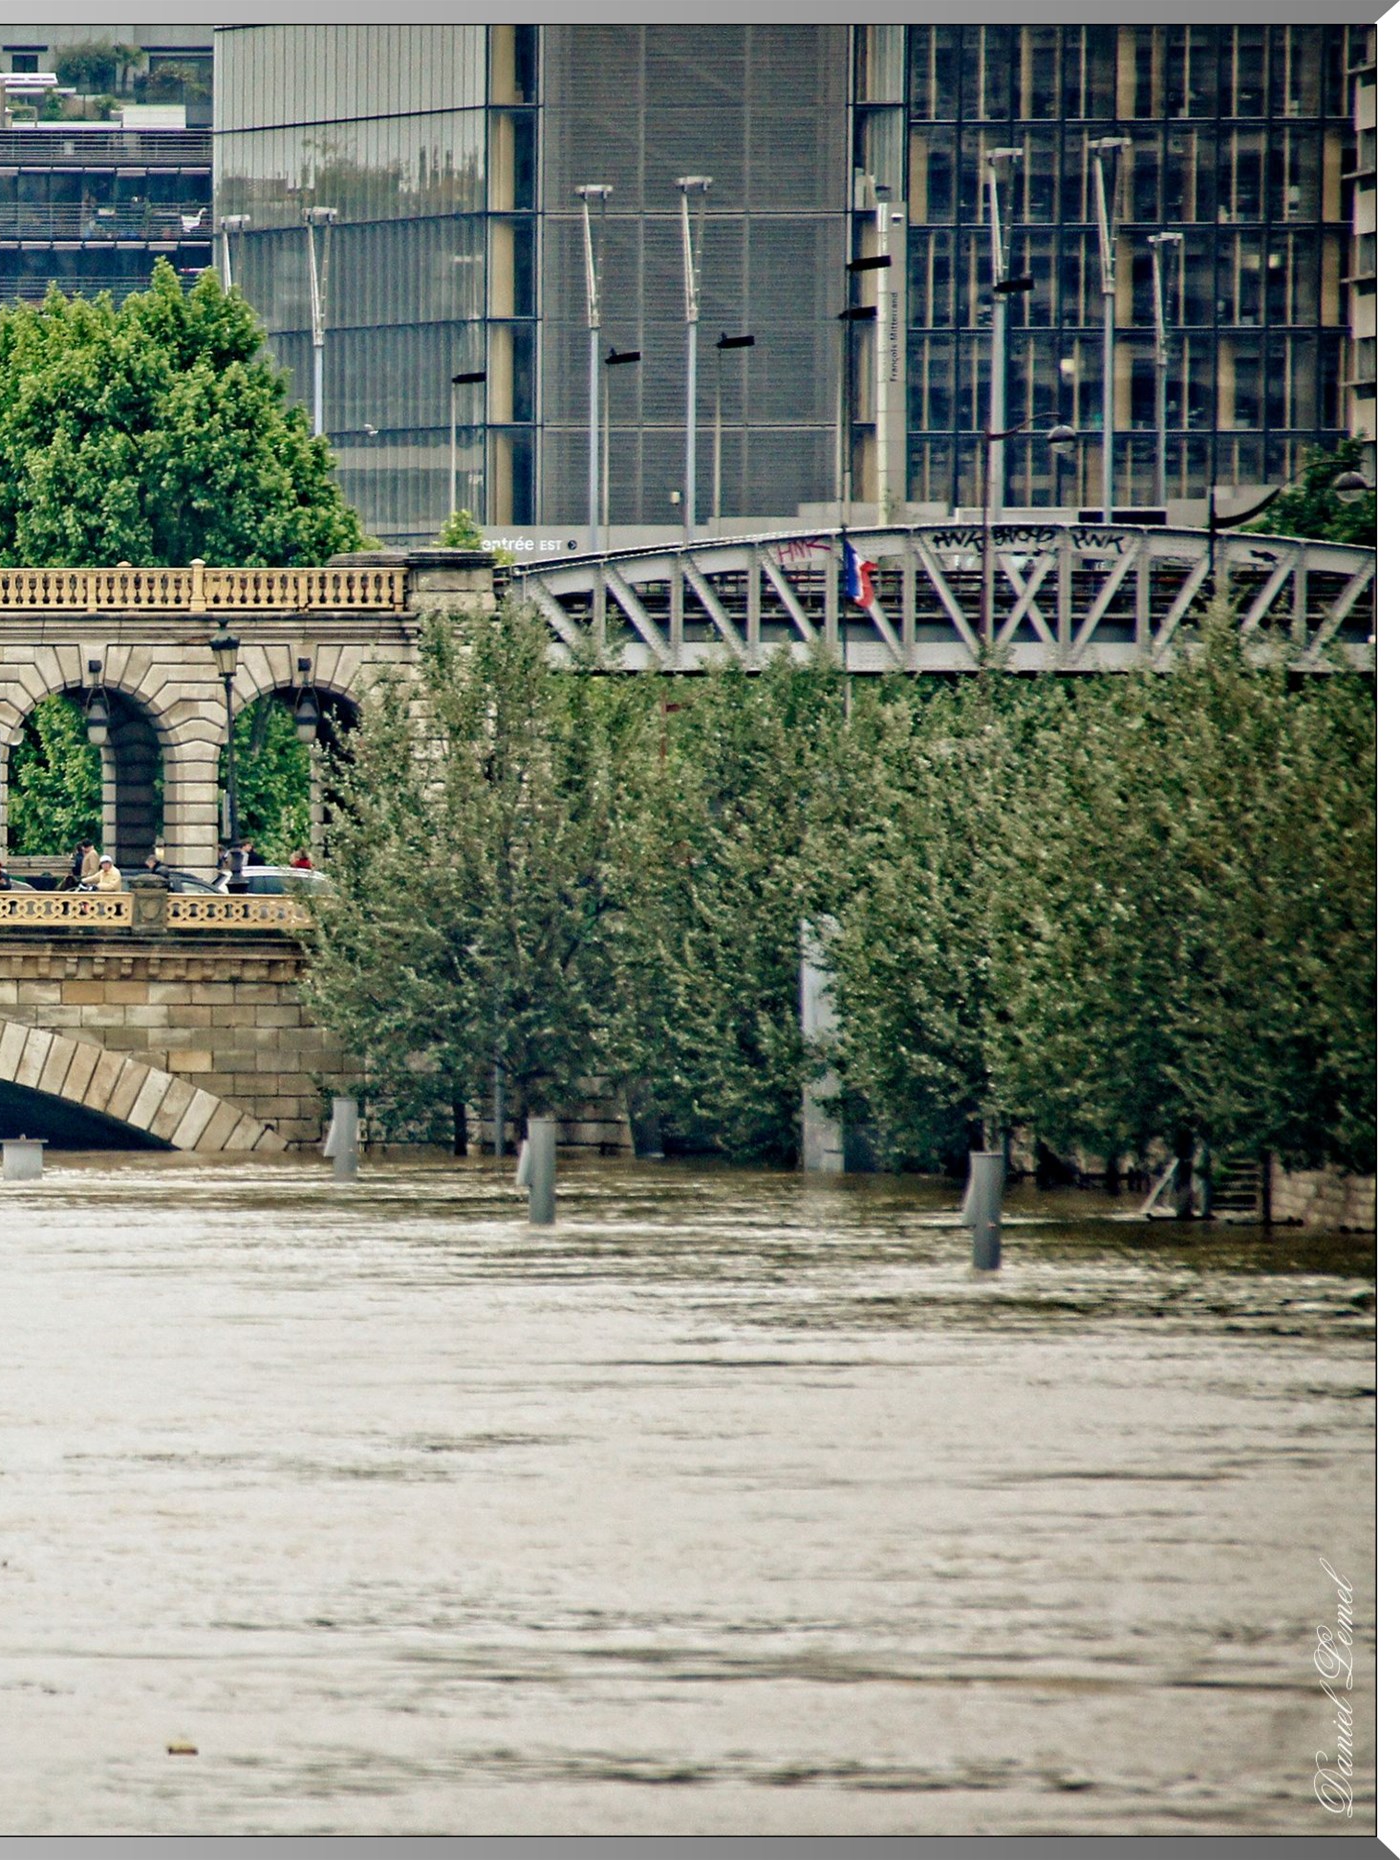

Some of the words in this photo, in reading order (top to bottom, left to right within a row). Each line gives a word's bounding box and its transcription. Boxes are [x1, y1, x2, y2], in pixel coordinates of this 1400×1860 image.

[889, 291, 899, 341] Mitterrand
[889, 342, 901, 382] François
[481, 535, 535, 552] entrée
[539, 540, 562, 552] EST
